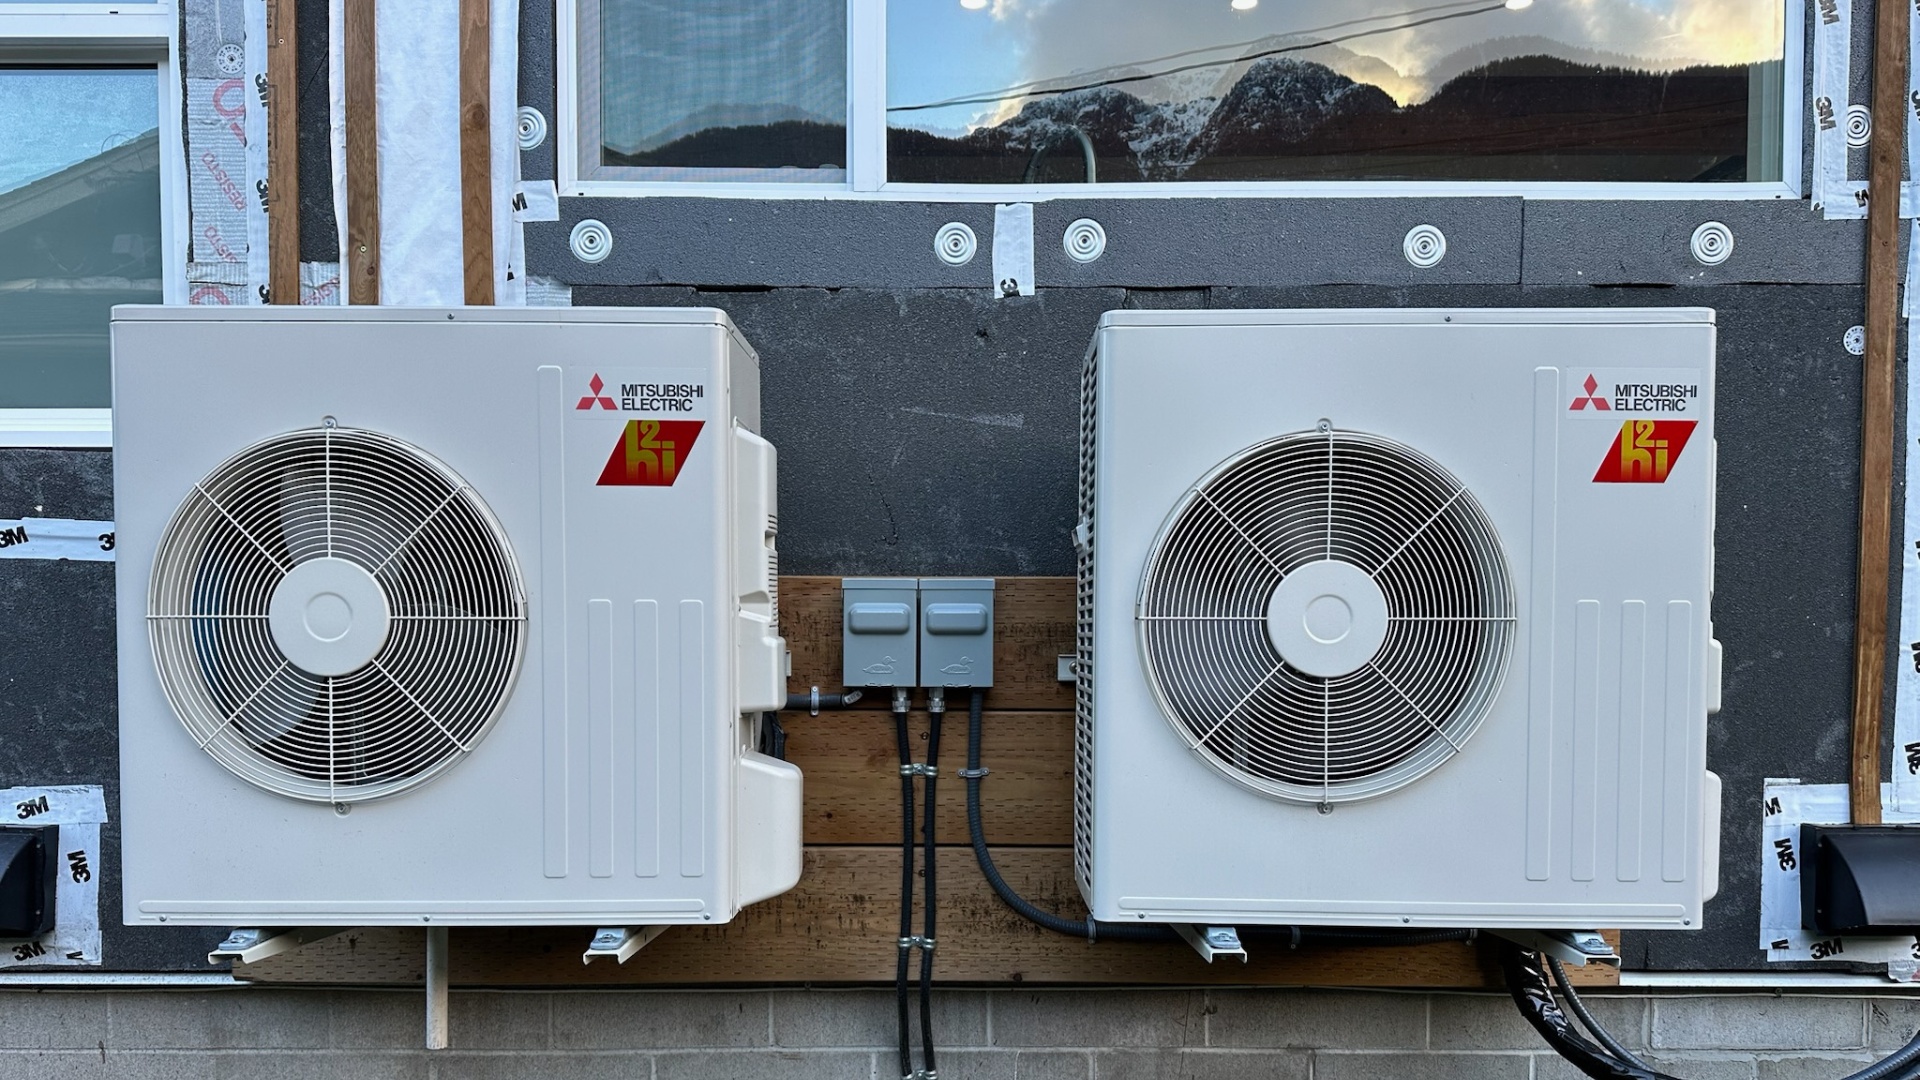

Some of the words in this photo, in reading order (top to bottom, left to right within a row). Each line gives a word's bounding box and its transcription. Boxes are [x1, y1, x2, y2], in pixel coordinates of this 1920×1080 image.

[1816, 96, 1837, 131] 3M
[512, 192, 528, 213] M
[621, 384, 704, 398] MITSUBISHI
[1615, 384, 1698, 398] MITSUBISHI
[621, 398, 693, 412] ELECTRIC
[1614, 398, 1687, 412] ELECTRIC
[98, 532, 115, 551] 3
[16, 796, 49, 819] 3M
[1765, 797, 1782, 817] M
[1774, 838, 1797, 871] 3M
[67, 850, 91, 883] 3M
[12, 941, 46, 961] 3M
[1810, 938, 1844, 960] 3M
